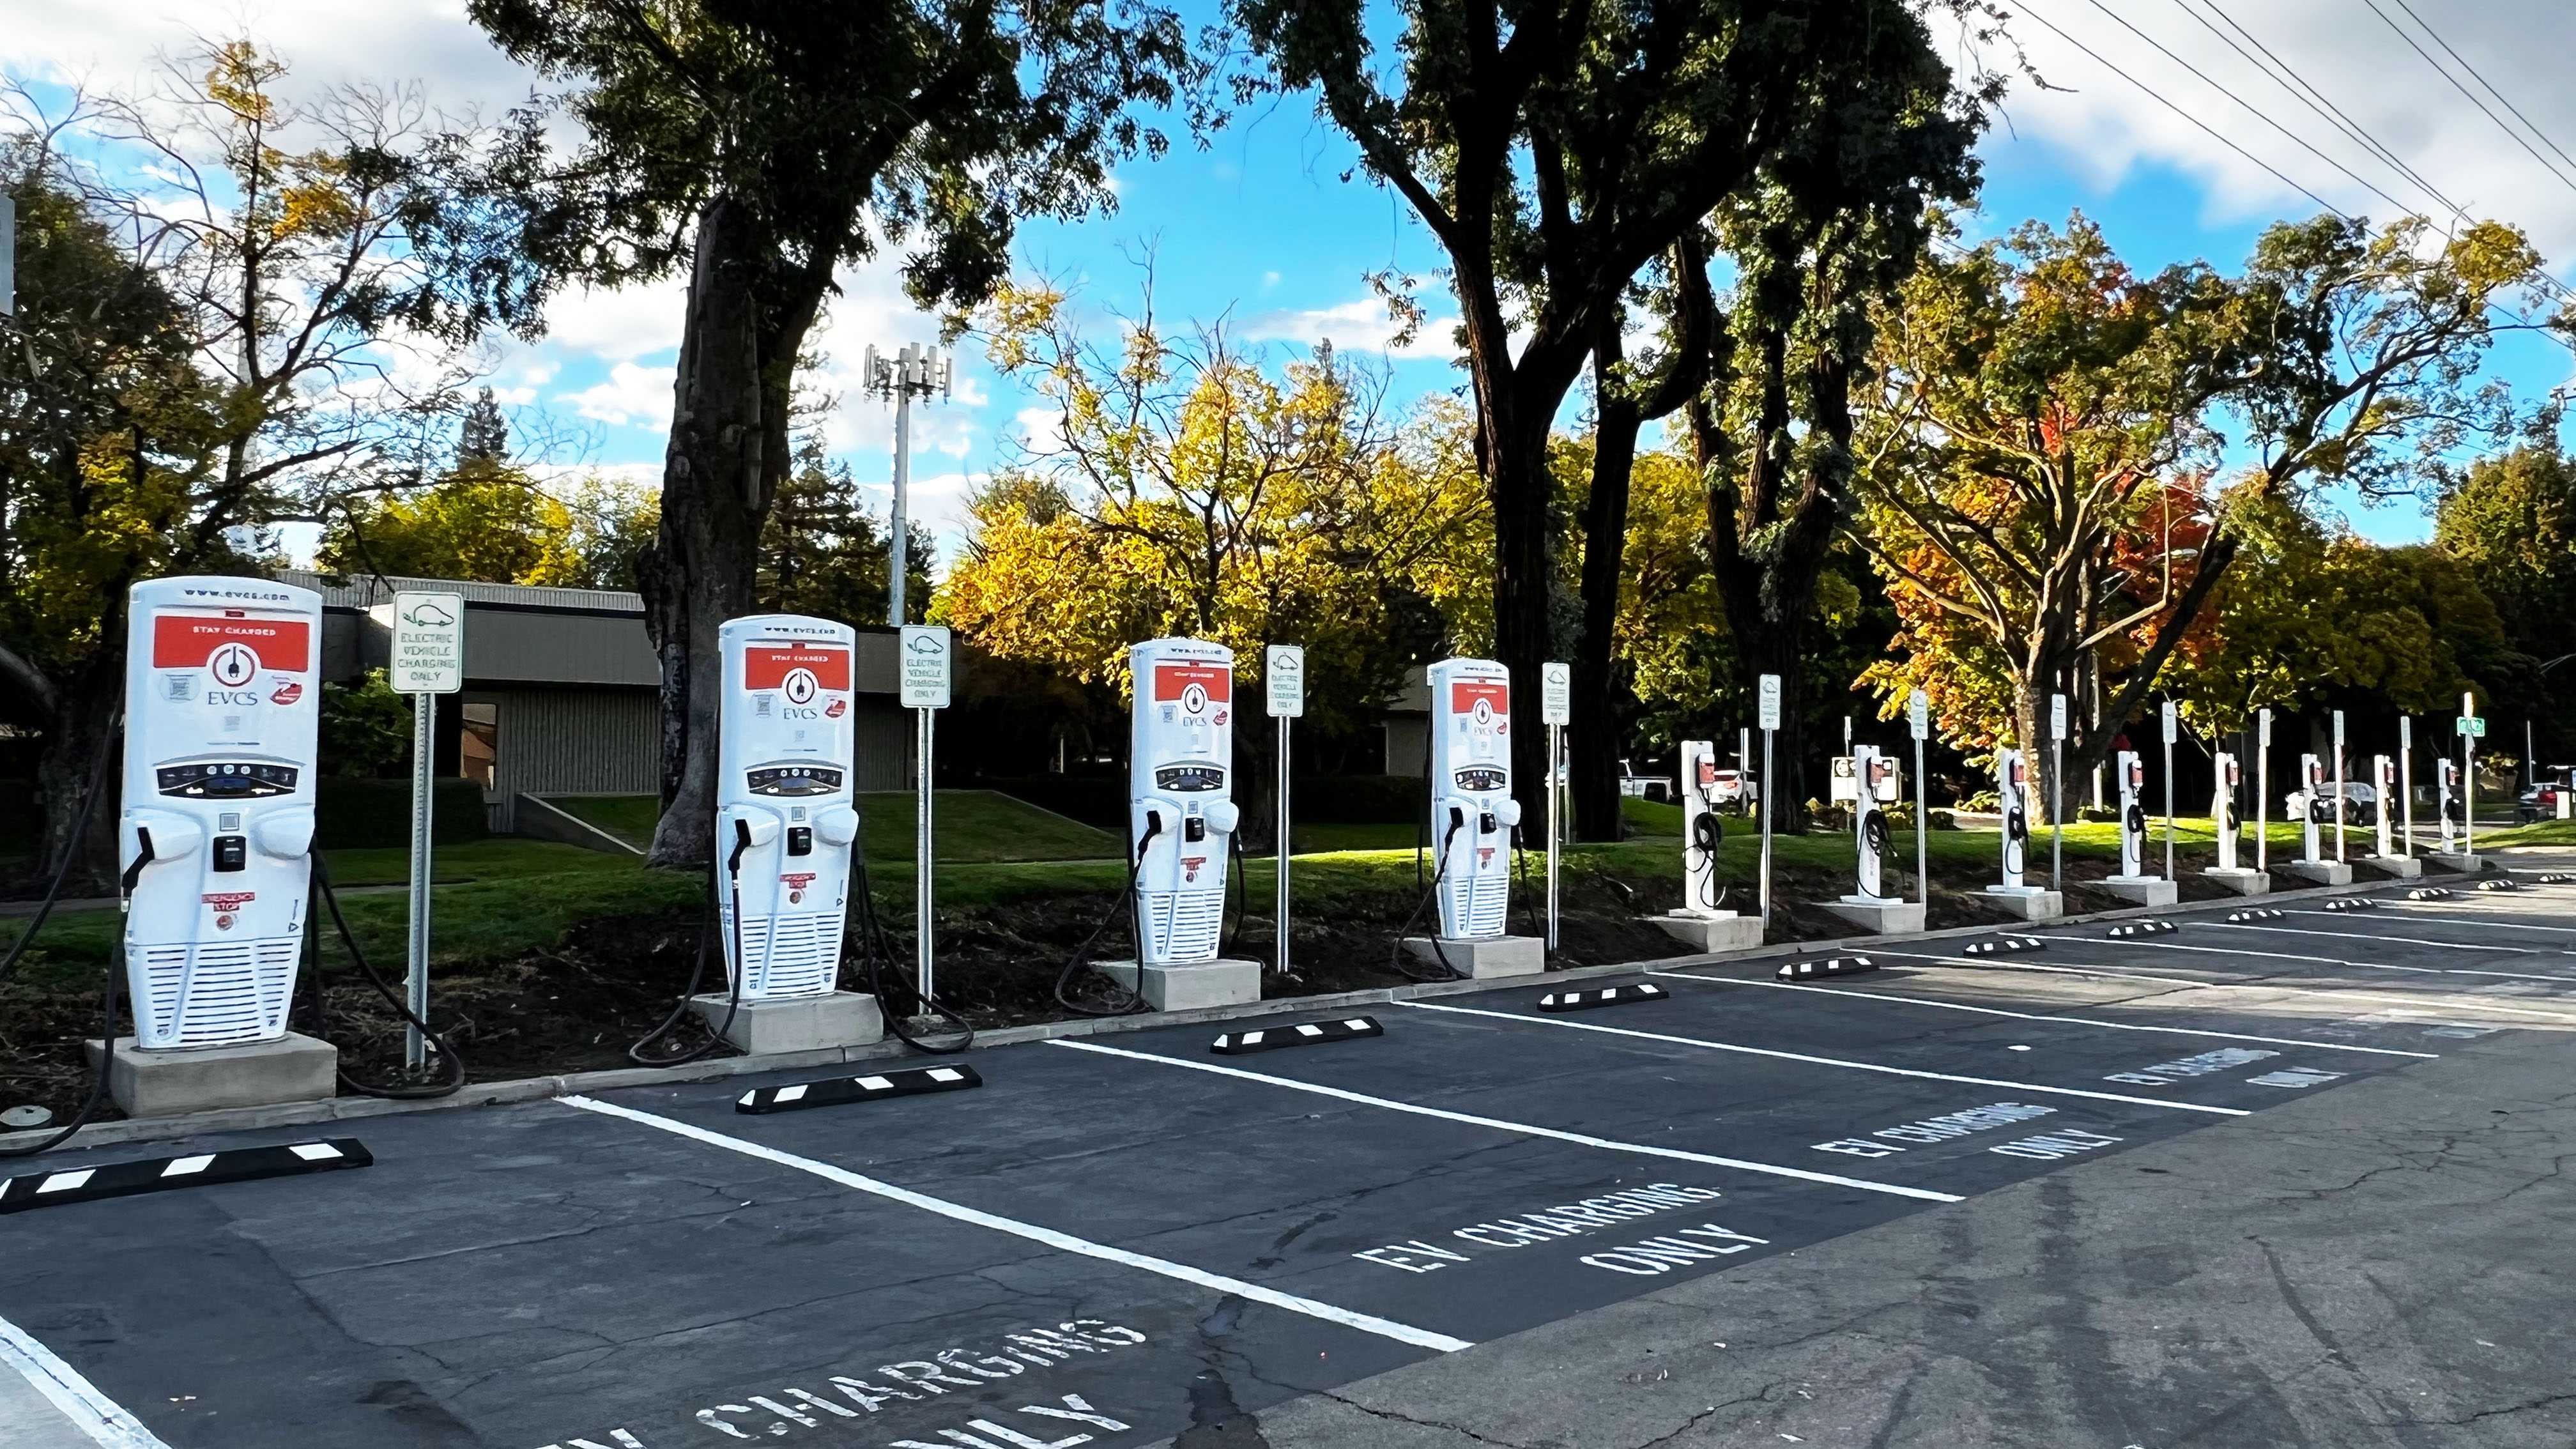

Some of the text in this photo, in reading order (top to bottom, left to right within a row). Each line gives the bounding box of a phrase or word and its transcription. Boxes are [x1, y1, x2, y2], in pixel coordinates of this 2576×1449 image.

[208, 691, 258, 706] EVCS
[784, 708, 818, 719] EVCS
[1351, 1183, 1721, 1273] EV CHARGING
[1579, 1223, 1770, 1276] ONLY
[695, 1319, 1146, 1441] CHARGING
